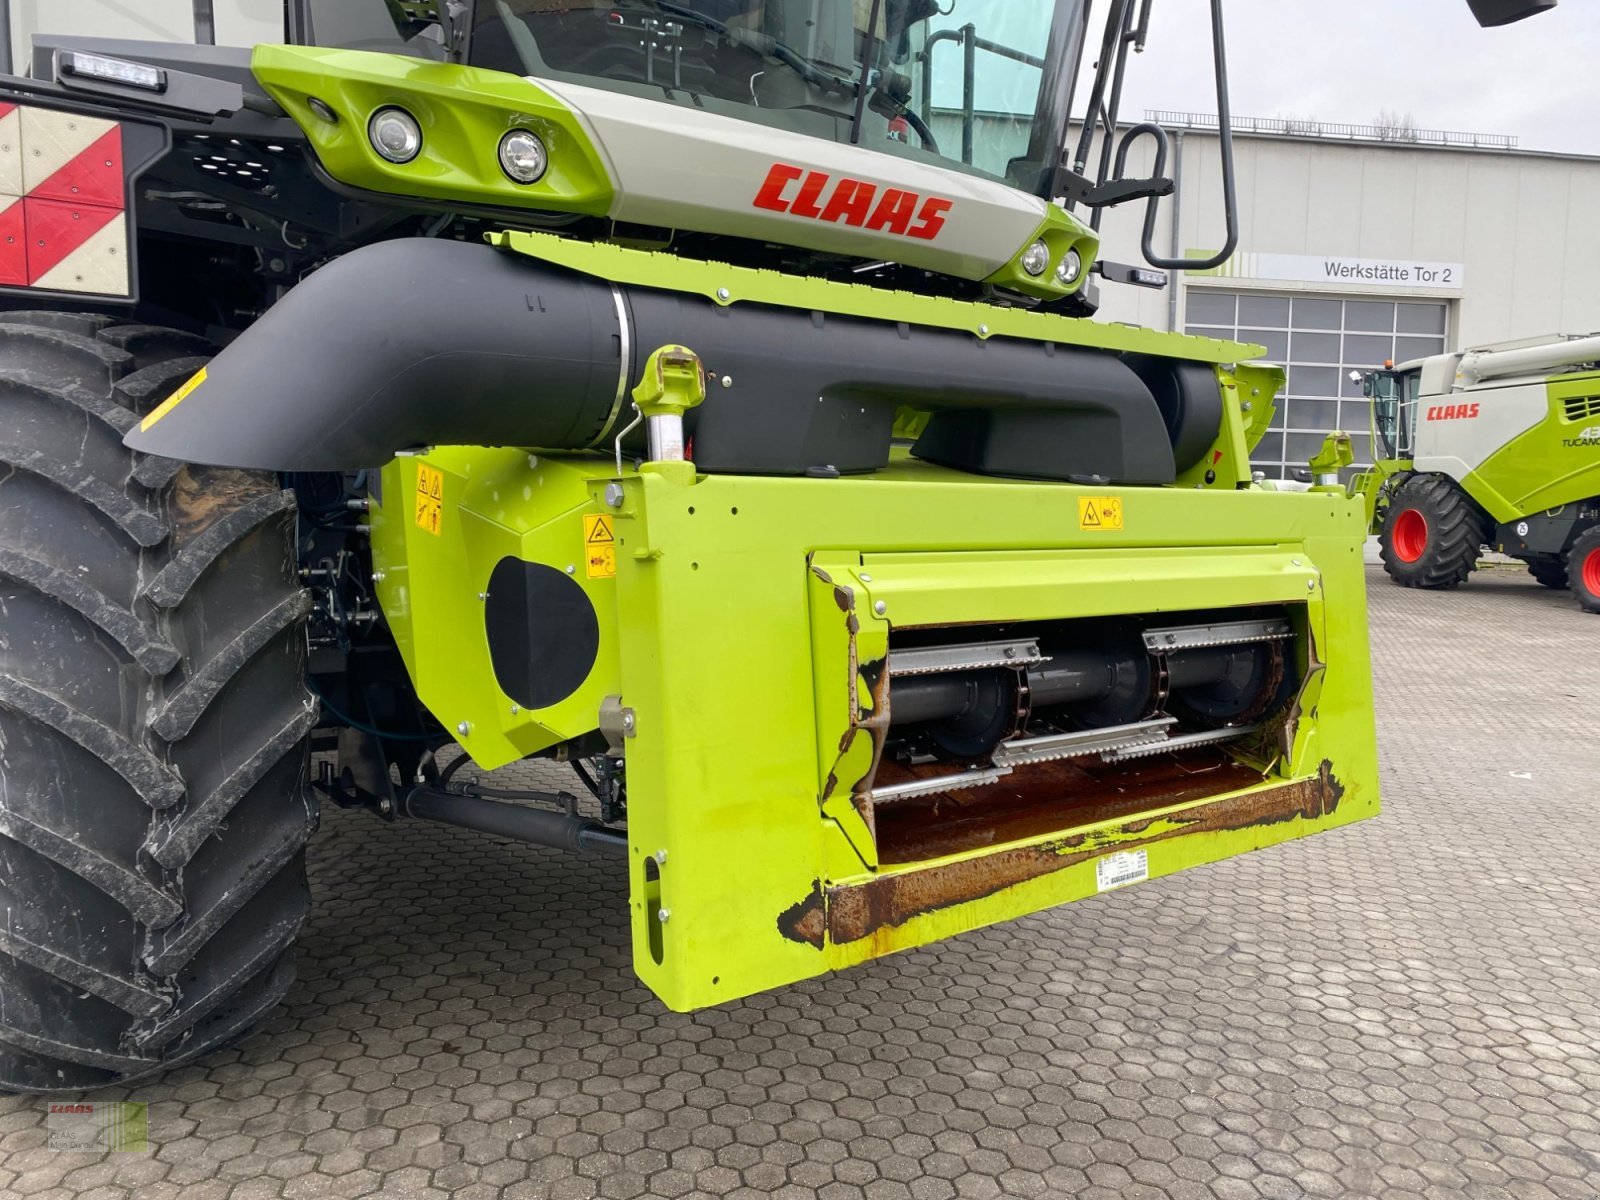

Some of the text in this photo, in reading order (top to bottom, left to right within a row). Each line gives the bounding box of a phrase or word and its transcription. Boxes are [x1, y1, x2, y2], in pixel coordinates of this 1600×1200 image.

[753, 163, 954, 240] CLAAS
[1324, 261, 1452, 283] Werkstätte Tor 2
[1426, 403, 1480, 421] CLAAS
